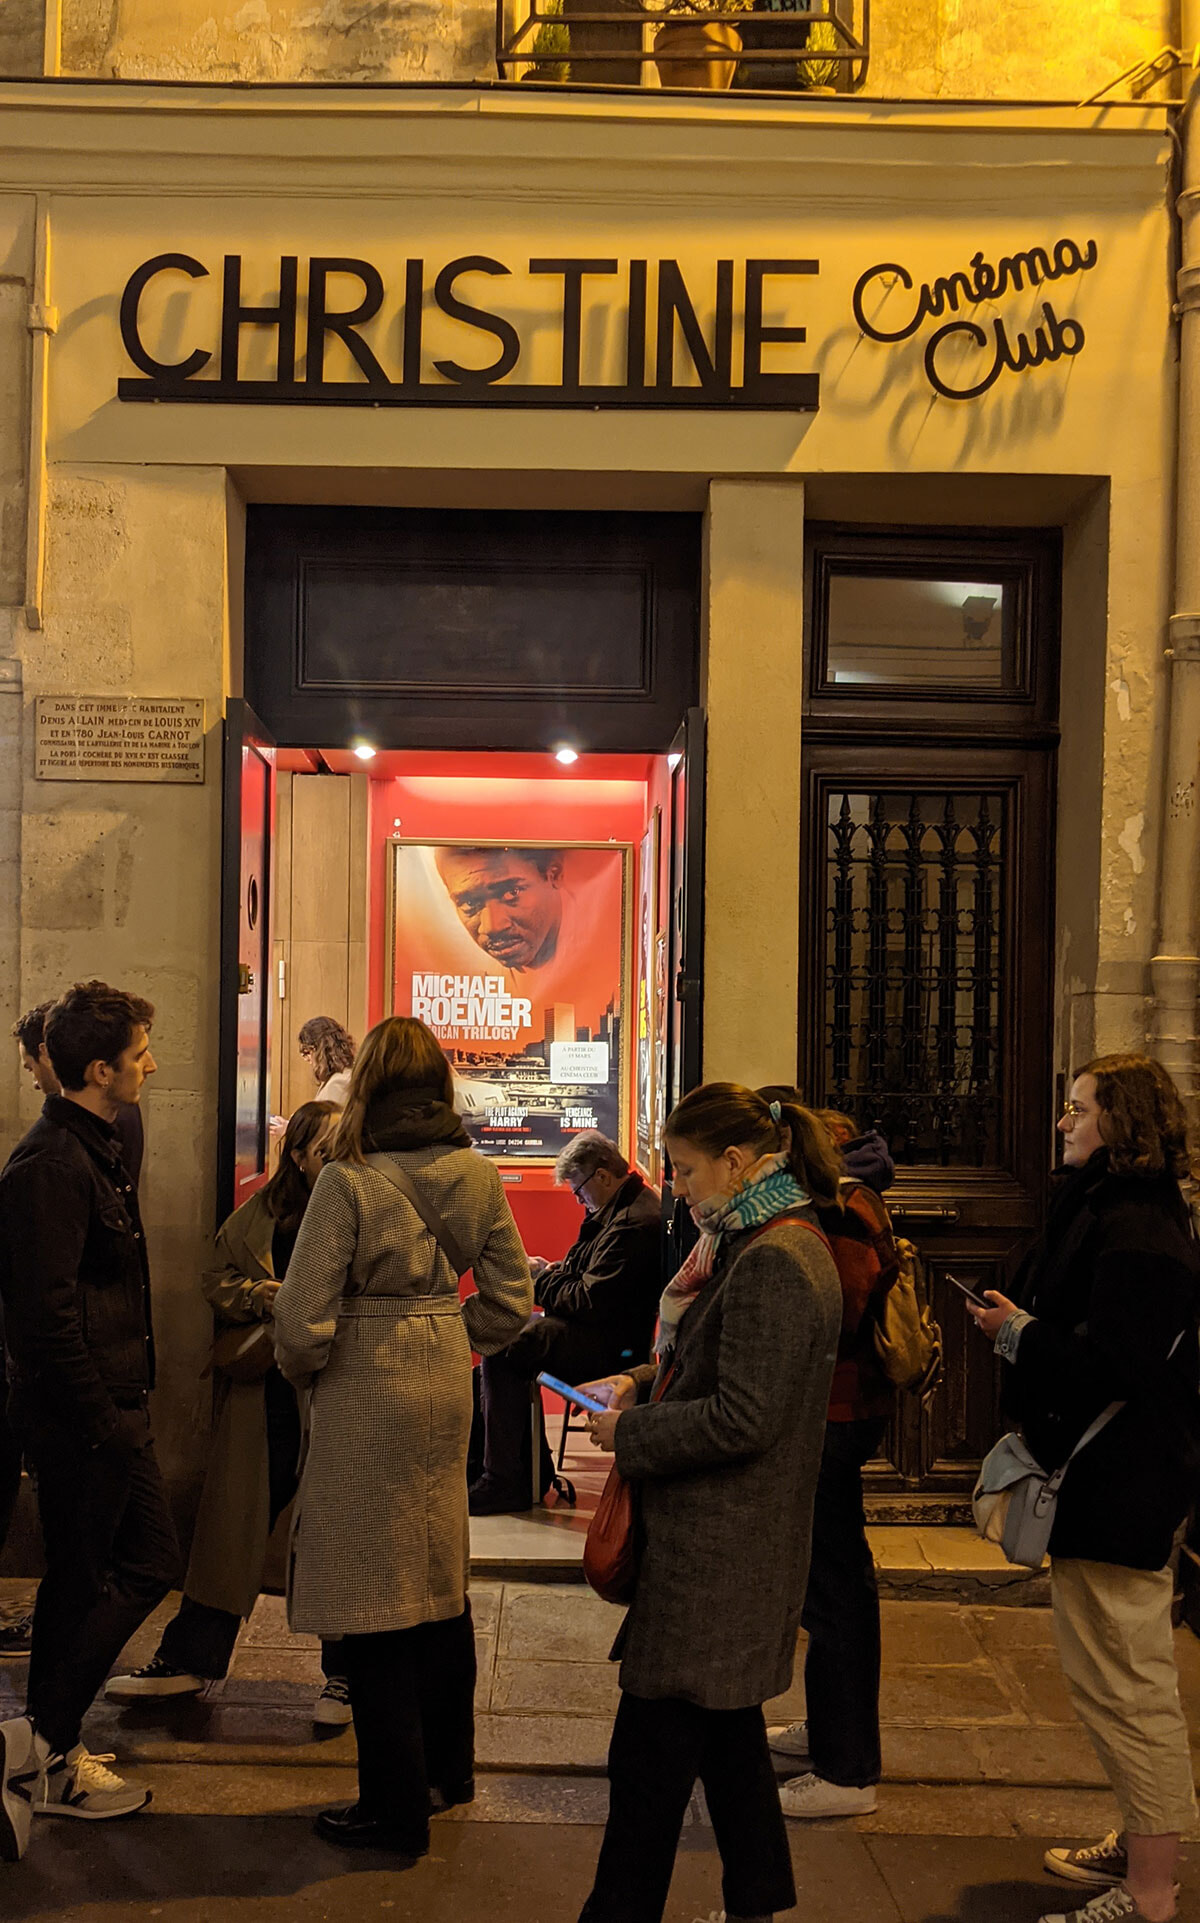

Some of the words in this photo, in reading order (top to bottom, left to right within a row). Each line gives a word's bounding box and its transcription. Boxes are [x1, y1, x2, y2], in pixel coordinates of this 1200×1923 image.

[853, 239, 1097, 343] Cinéma
[119, 252, 818, 393] CHRISTINE
[925, 302, 1084, 400] Club
[55, 704, 76, 712] DANS
[79, 704, 95, 712] CET
[139, 705, 185, 713] HABITAIENT
[68, 716, 105, 726] ALLAIN
[144, 719, 153, 727] DE
[155, 717, 182, 728] LOUIS
[184, 718, 201, 728] XIV
[50, 730, 59, 738] ET
[61, 730, 71, 738] EN
[74, 729, 94, 739] 1780
[148, 730, 190, 741] CARNOT
[412, 975, 511, 998] MICHAEL
[411, 997, 532, 1027] ROEMER
[427, 1026, 459, 1040] RICAN
[462, 1026, 519, 1040] TRILOGY
[490, 1117, 523, 1127] HARRY
[560, 1117, 571, 1128] IS
[572, 1117, 598, 1128] MINE
